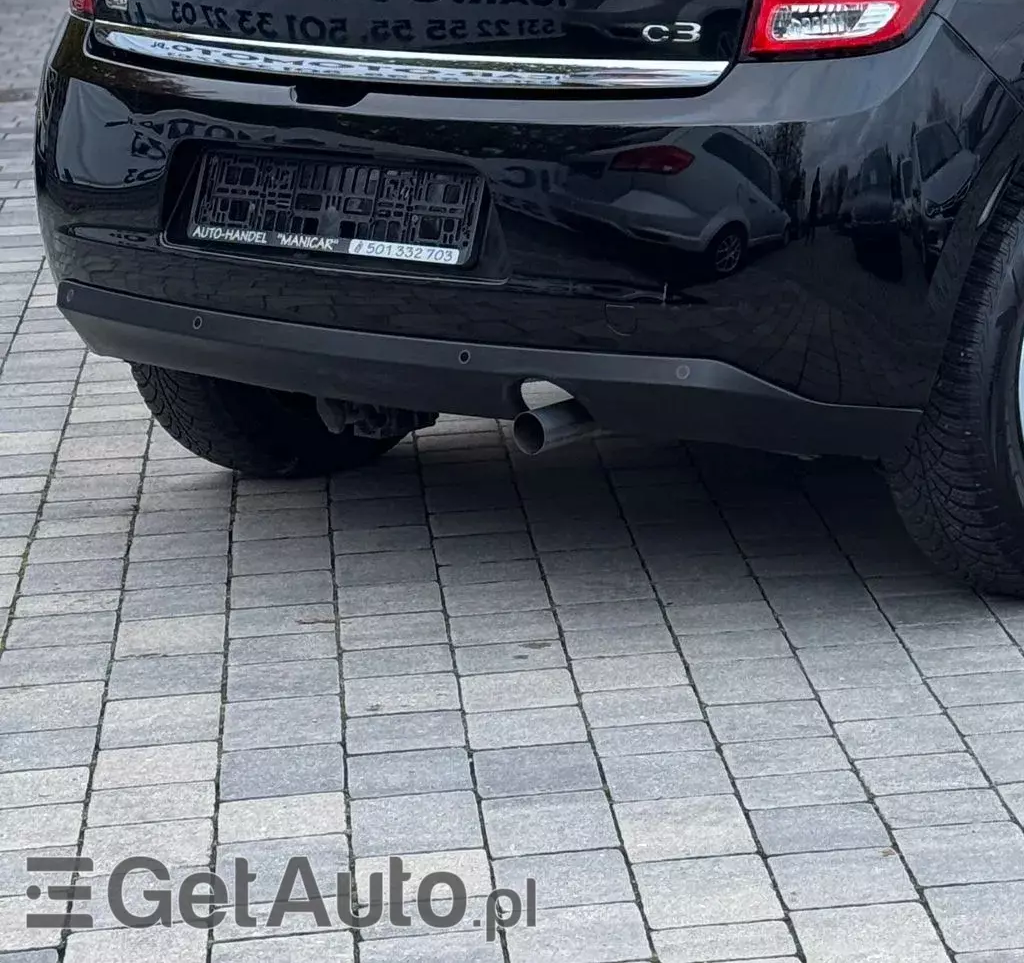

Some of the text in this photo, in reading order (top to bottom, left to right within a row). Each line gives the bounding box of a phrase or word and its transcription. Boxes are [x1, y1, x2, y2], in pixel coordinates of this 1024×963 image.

[642, 21, 702, 42] C3
[192, 226, 268, 244] AUTO-HANDEL
[366, 242, 392, 256] 501
[395, 245, 422, 258] 332
[427, 248, 453, 262] 703
